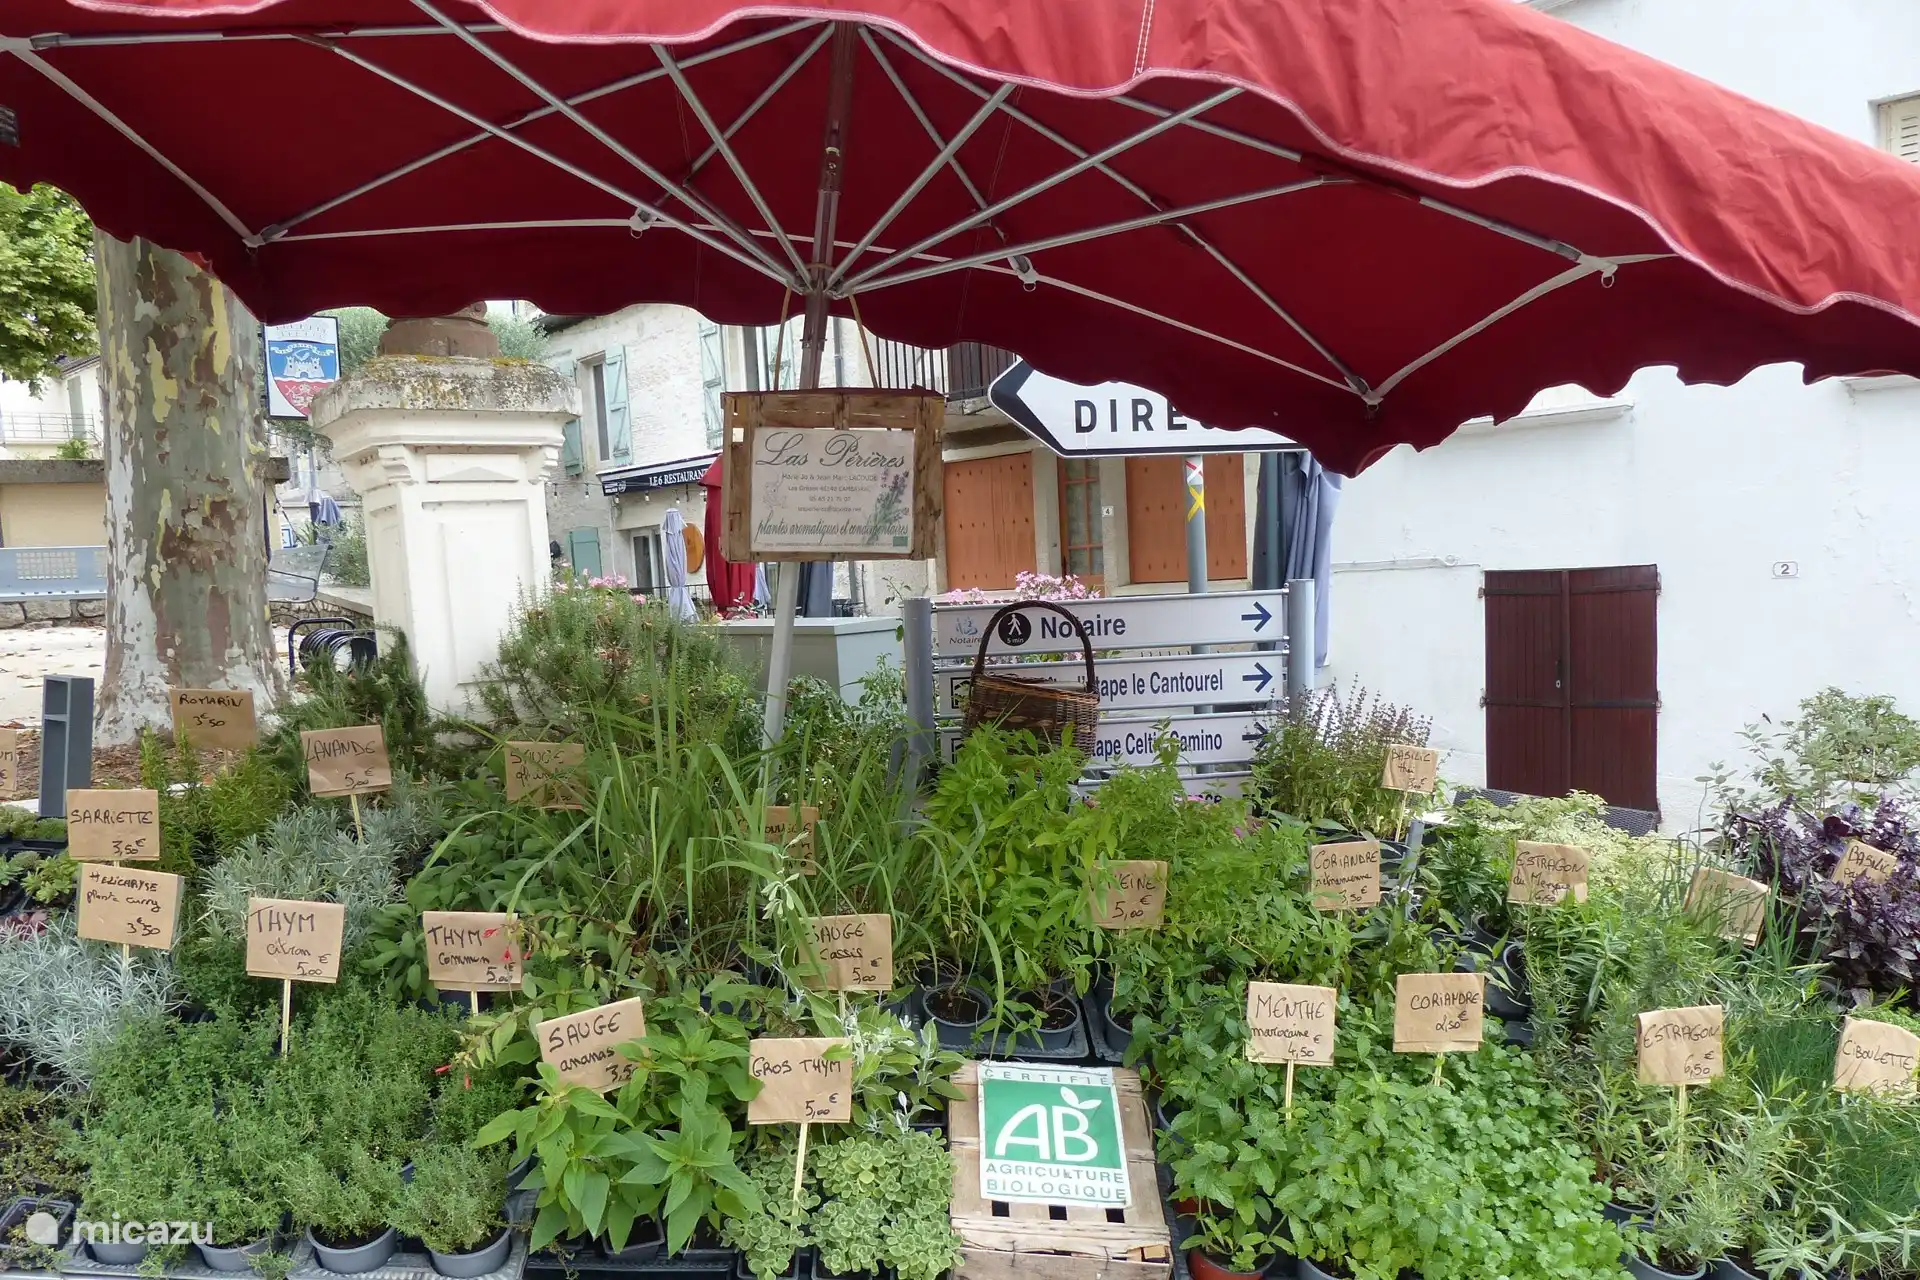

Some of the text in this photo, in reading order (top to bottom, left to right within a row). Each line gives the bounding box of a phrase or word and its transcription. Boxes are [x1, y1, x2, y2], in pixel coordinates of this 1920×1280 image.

[755, 431, 809, 467] Las
[649, 476, 658, 487] LE
[658, 475, 663, 486] 6
[1780, 563, 1790, 575] 2
[1132, 673, 1146, 695] le
[1150, 669, 1223, 694] Cantourel
[305, 738, 376, 762] LAVANDE
[1391, 748, 1431, 762] BASILIC
[1515, 850, 1585, 873] ESTRAGON
[250, 905, 315, 936] THYM
[427, 925, 483, 949] THYM
[1255, 994, 1325, 1020] MENTHE
[548, 1012, 621, 1053] SAUGE
[1251, 1022, 1309, 1039] marocaine
[1643, 1022, 1721, 1048] ESTRAGON
[799, 1058, 842, 1078] THYM
[994, 1103, 1099, 1162] AB
[985, 1162, 1126, 1184] AGRICULTURE
[986, 1178, 1127, 1200] BIOLOGIQUE
